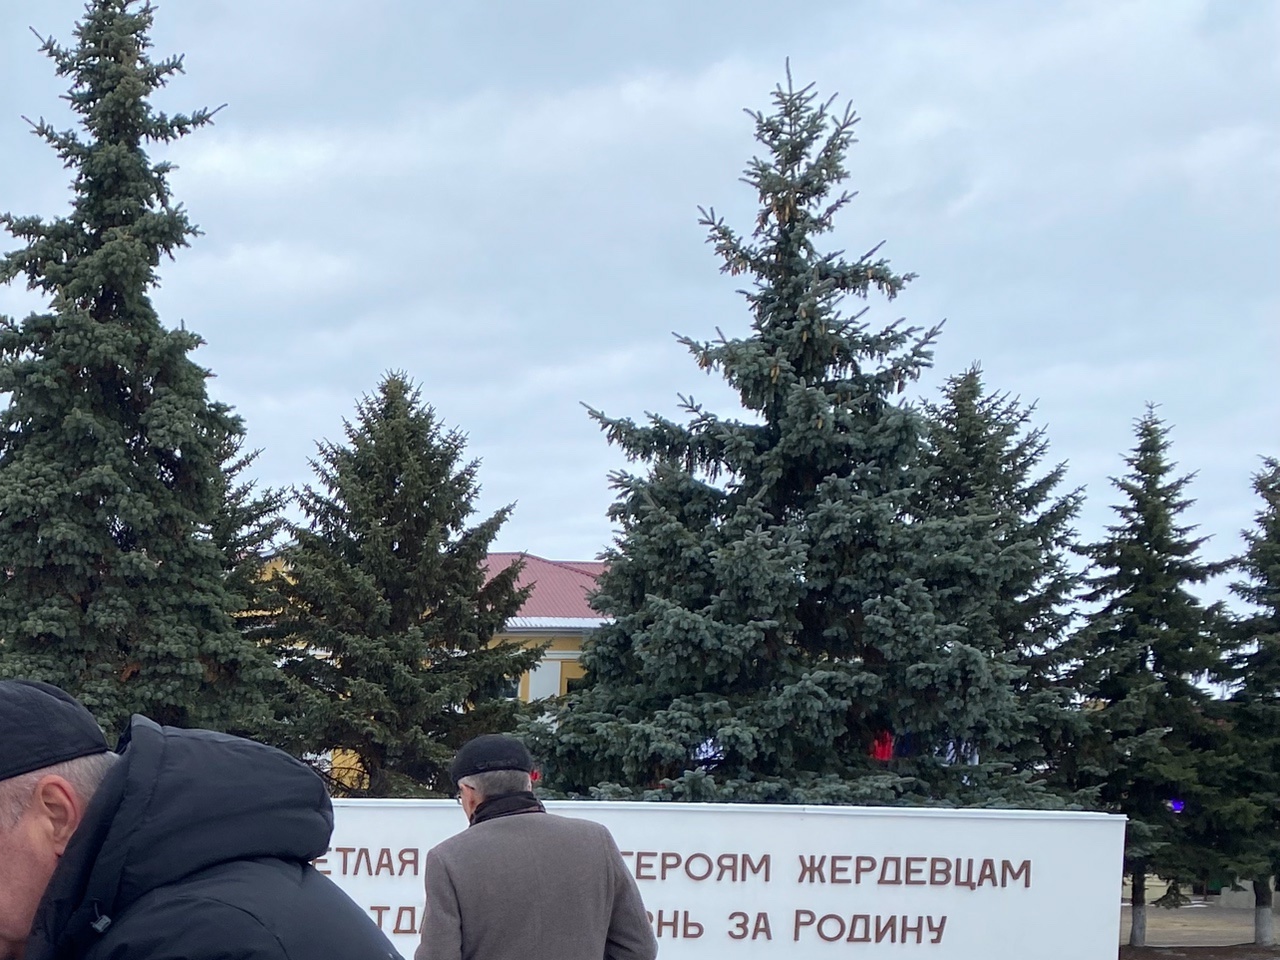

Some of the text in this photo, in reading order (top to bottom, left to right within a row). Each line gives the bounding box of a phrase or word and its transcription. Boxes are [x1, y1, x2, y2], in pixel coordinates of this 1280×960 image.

[312, 847, 419, 876] ЕТЛАЯ
[797, 854, 1032, 890] ЖЕРДЕВЦАМ
[728, 911, 773, 940] ЗА
